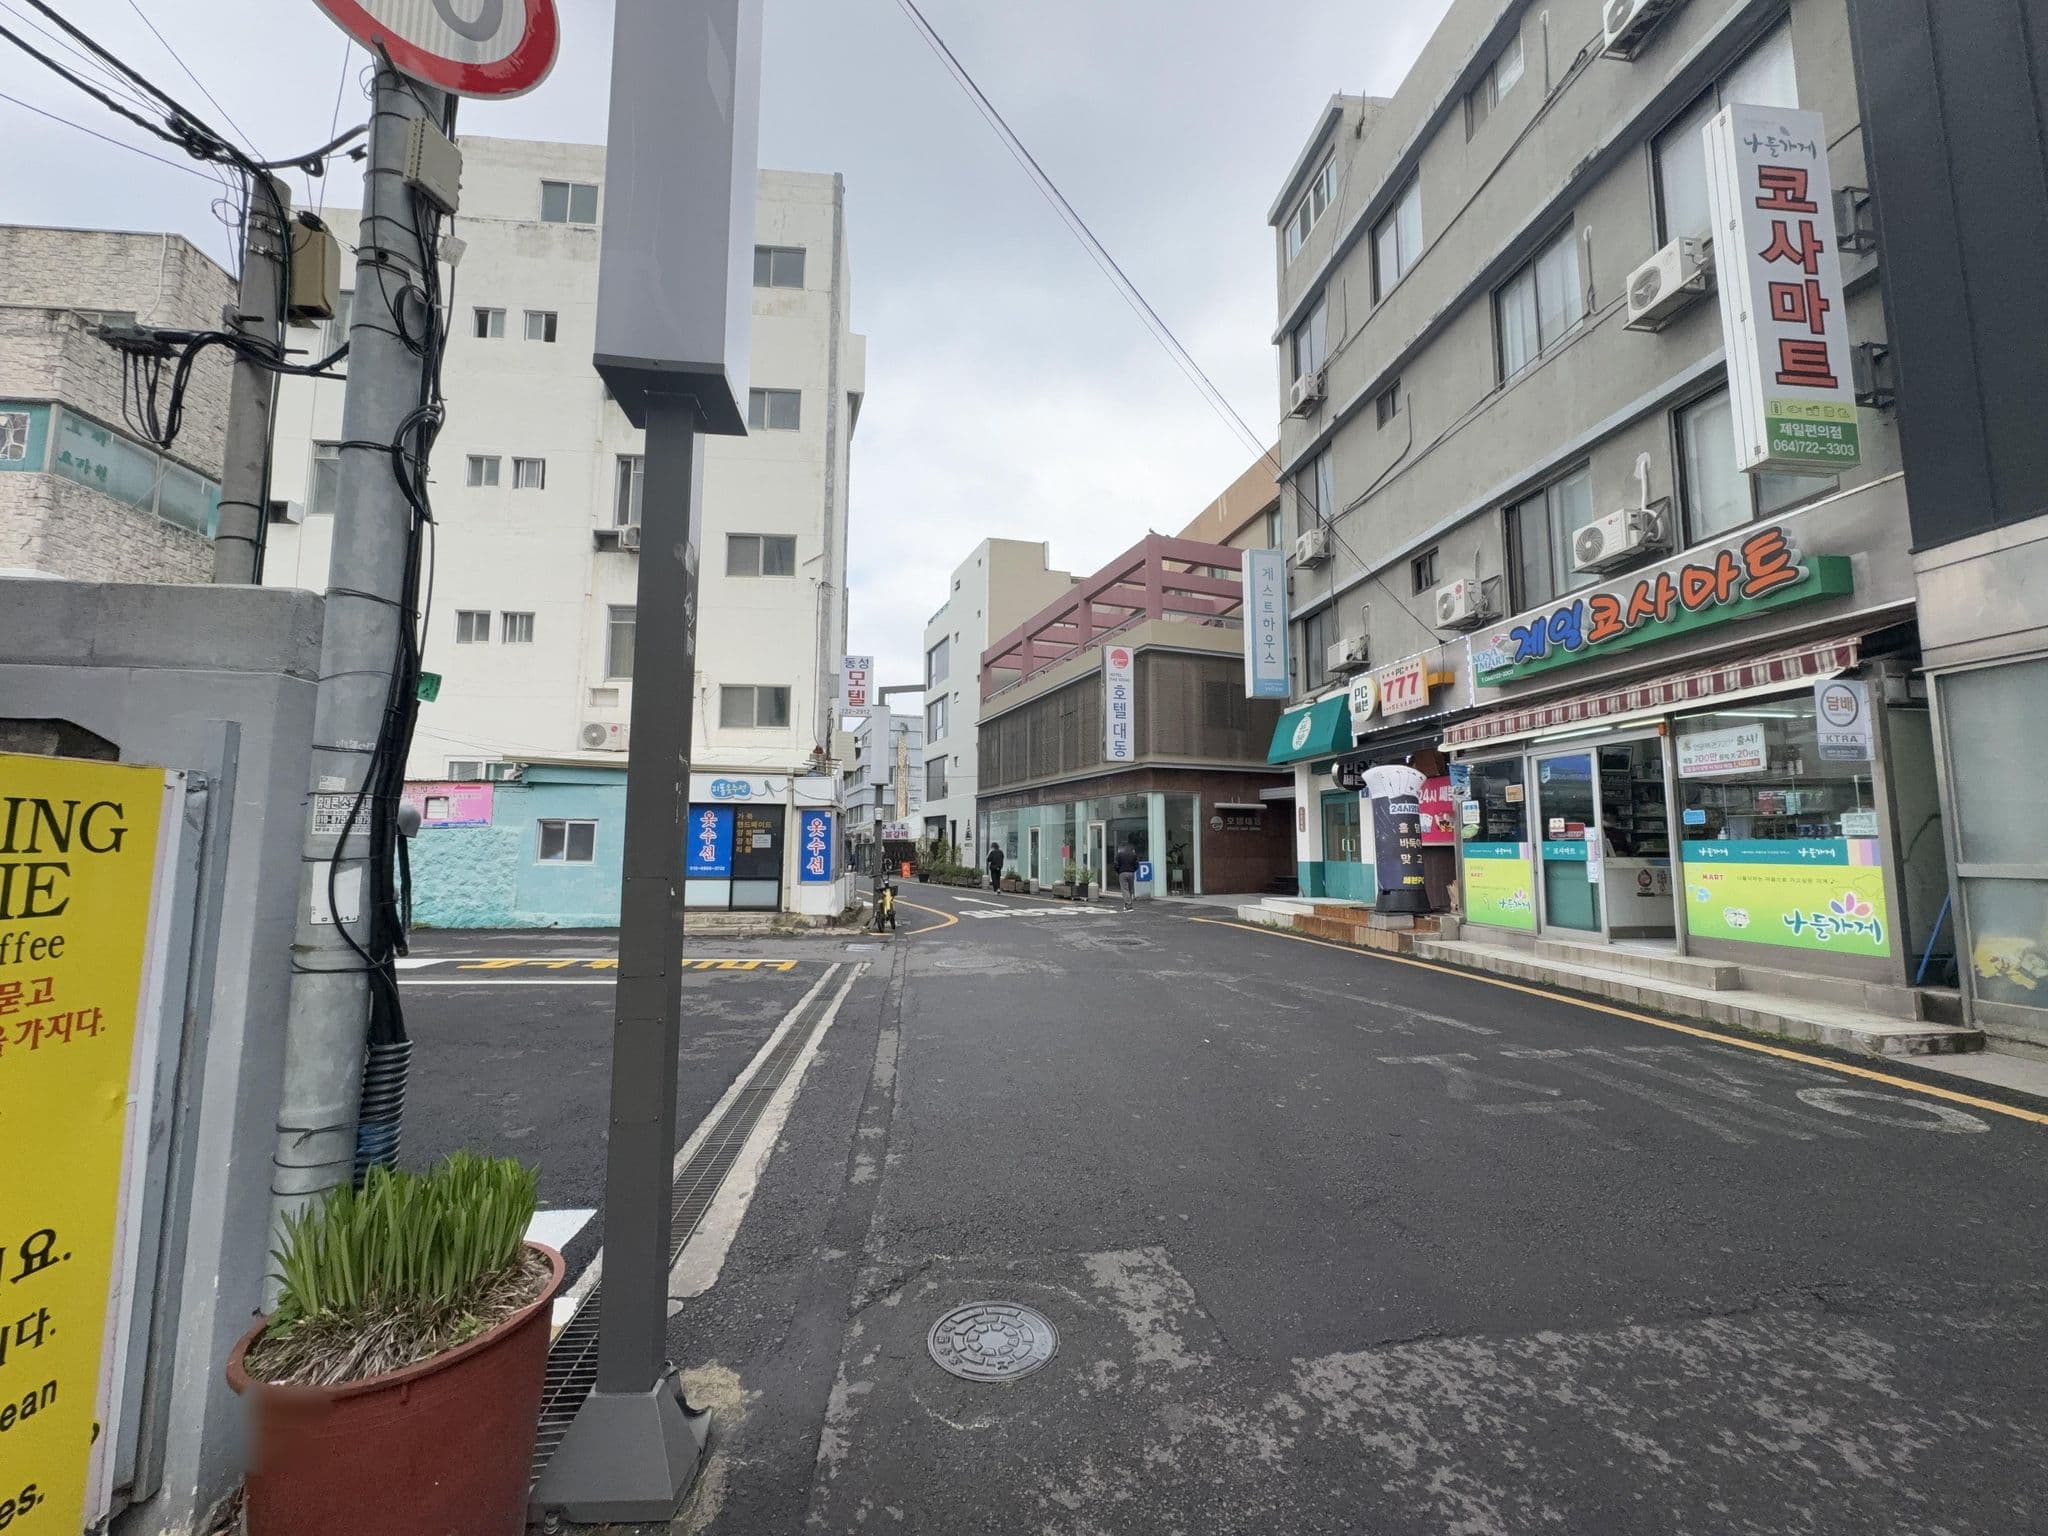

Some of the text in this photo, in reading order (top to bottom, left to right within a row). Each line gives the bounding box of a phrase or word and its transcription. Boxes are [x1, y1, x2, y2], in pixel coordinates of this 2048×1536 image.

[1756, 164, 1838, 389] 코사마트
[1780, 423, 1843, 440] 제일편의점
[1773, 439, 1856, 456] 064)722-3303
[1262, 567, 1277, 665] 게스트하우스
[1395, 667, 1405, 677] PC
[847, 671, 866, 707] 모텔
[1354, 685, 1368, 701] PC
[1383, 672, 1419, 703] 777
[1826, 696, 1854, 712] 담배
[1113, 684, 1127, 758] 호텔대동
[1826, 734, 1858, 743] KTRA
[1343, 762, 1367, 775] PC
[699, 810, 719, 862] 옷수선
[807, 818, 827, 875] 옷수선
[1140, 865, 1149, 878] P
[1783, 909, 1882, 944] 나들가게
